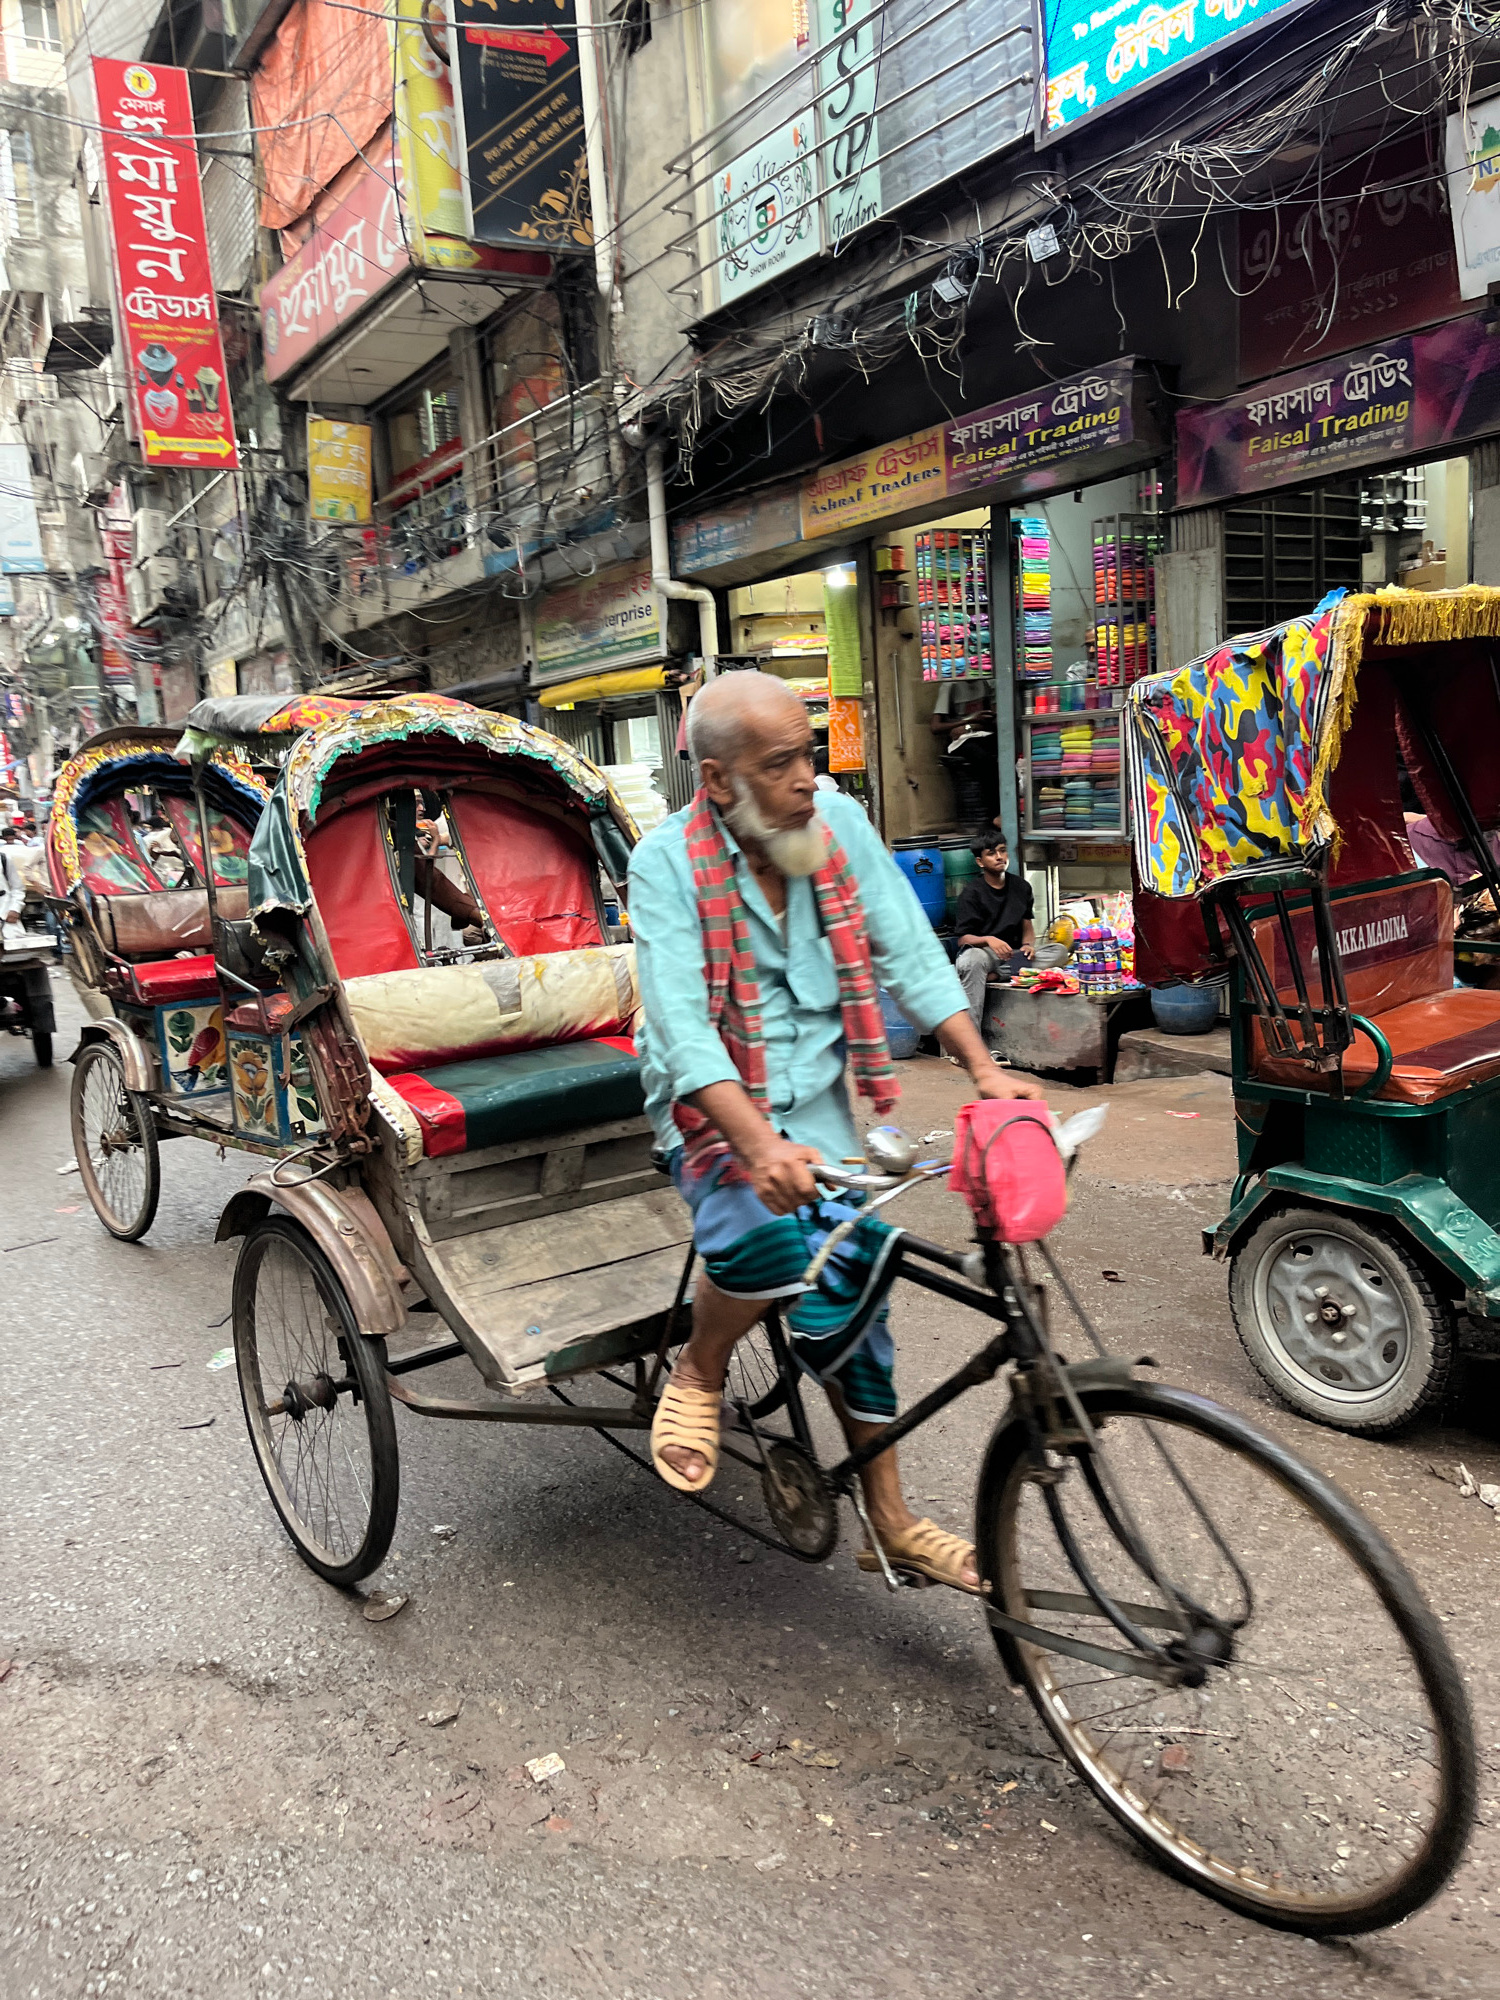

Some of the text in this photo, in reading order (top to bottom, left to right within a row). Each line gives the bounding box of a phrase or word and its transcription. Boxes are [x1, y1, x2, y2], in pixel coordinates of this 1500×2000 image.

[125, 286, 211, 321] ট্রেডার্স
[949, 375, 1123, 446] ফায়সাল ট্রেডিং
[1246, 352, 1412, 427] ফায়সাল ট্রেডিং
[951, 436, 1017, 469] Faisal
[1024, 406, 1121, 446] Trading
[1248, 399, 1410, 457] Faisal Trading
[1366, 914, 1409, 949] MADINA
